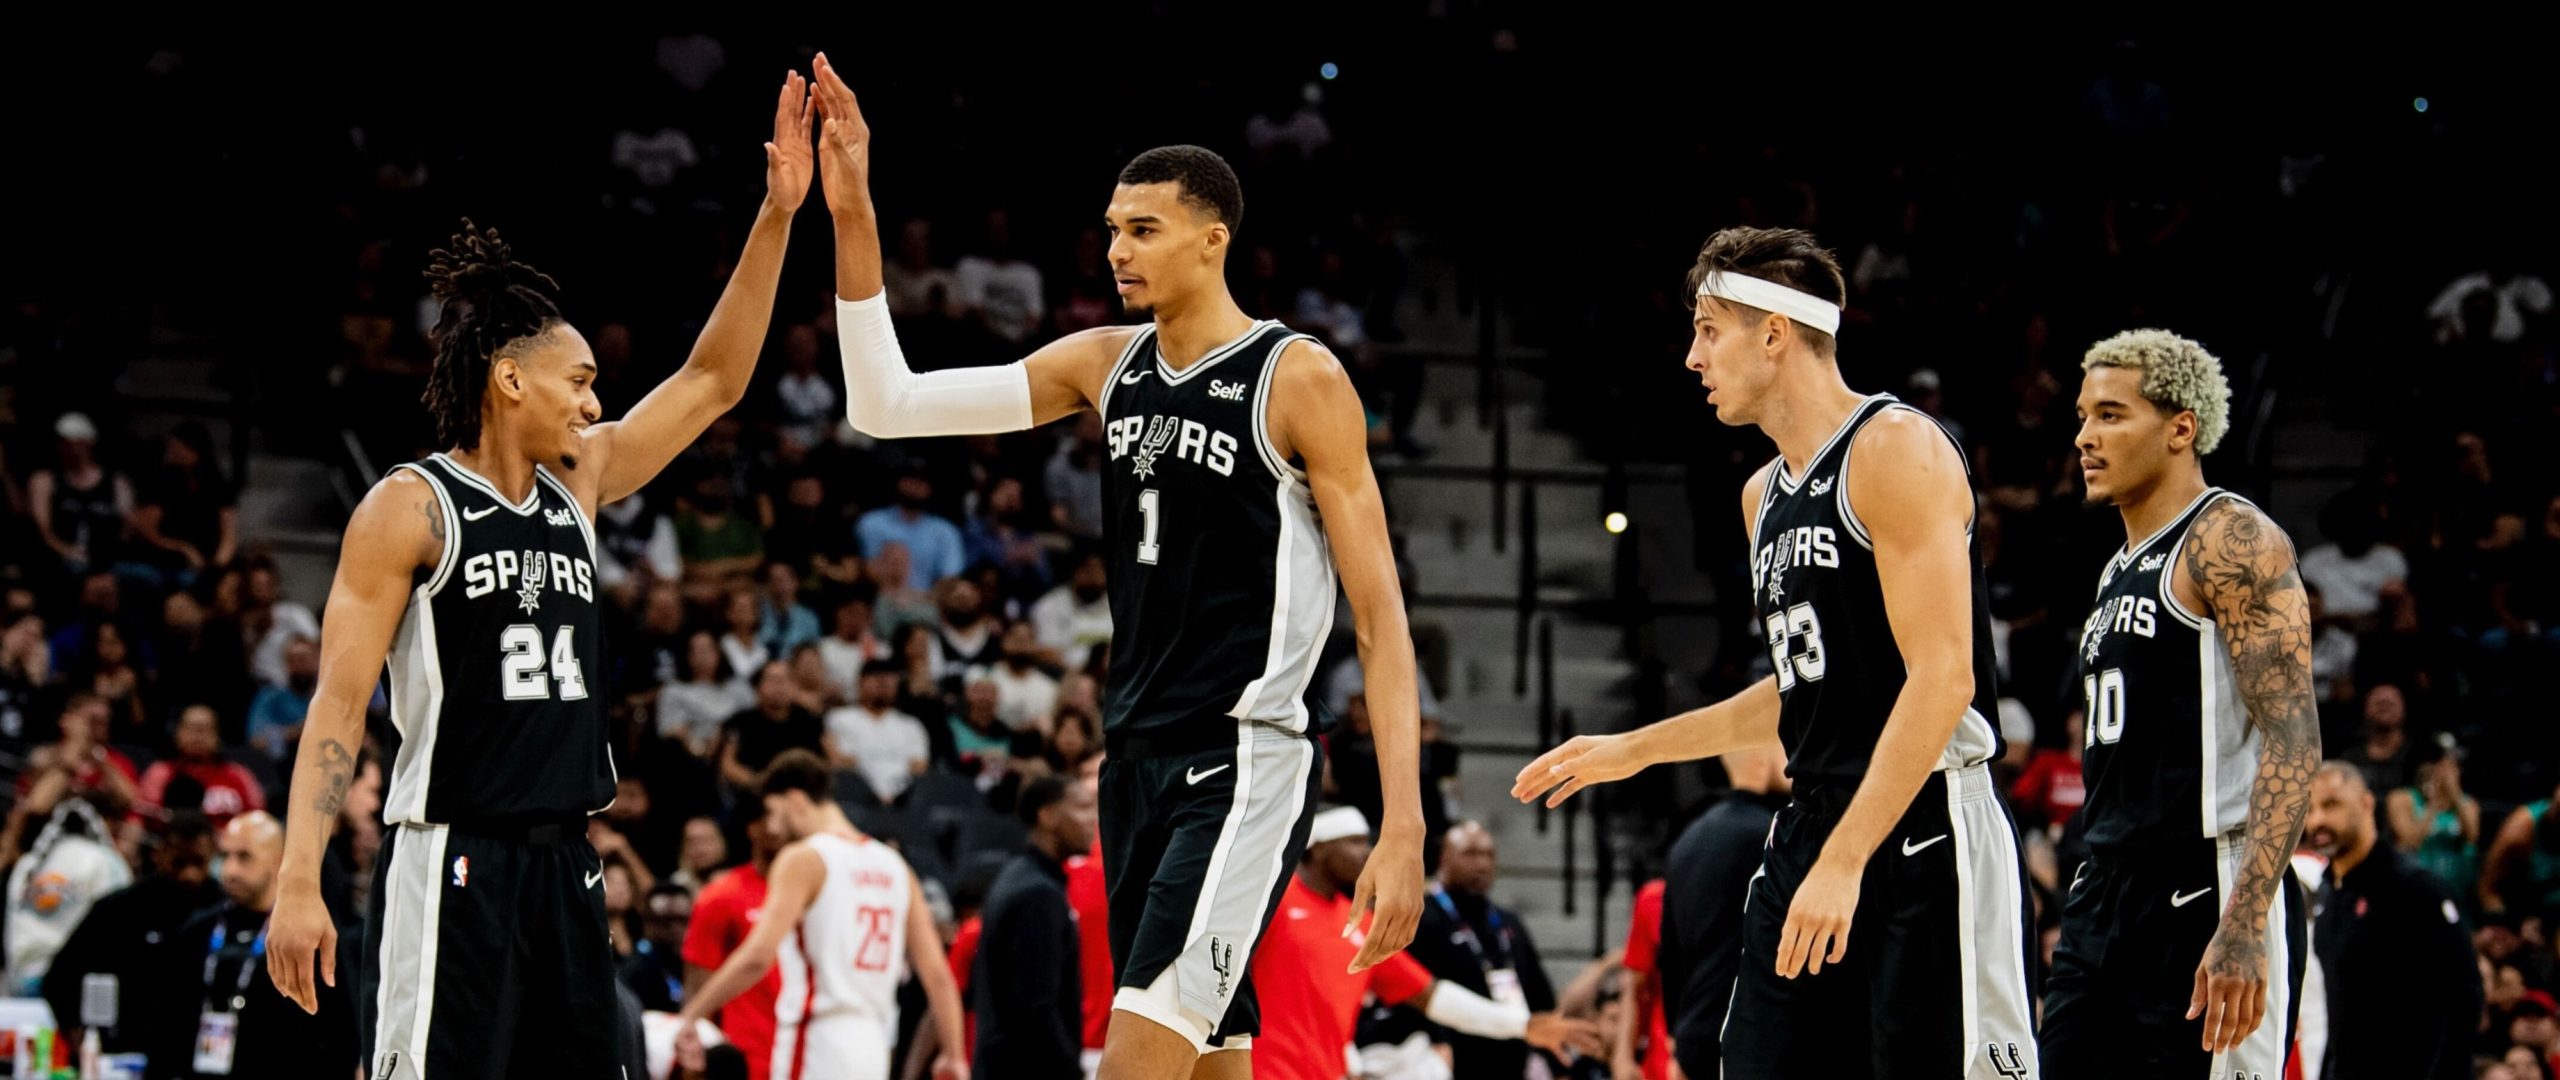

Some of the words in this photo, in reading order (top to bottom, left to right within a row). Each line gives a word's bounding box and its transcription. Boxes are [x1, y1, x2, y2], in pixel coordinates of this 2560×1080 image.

[1208, 379, 1247, 401] Self.
[1107, 414, 1239, 482] SPURS
[544, 508, 576, 526] Self.
[1137, 488, 1160, 566] 1
[464, 549, 594, 616] SPURS
[500, 624, 589, 701] 24
[1766, 601, 1827, 693] 23
